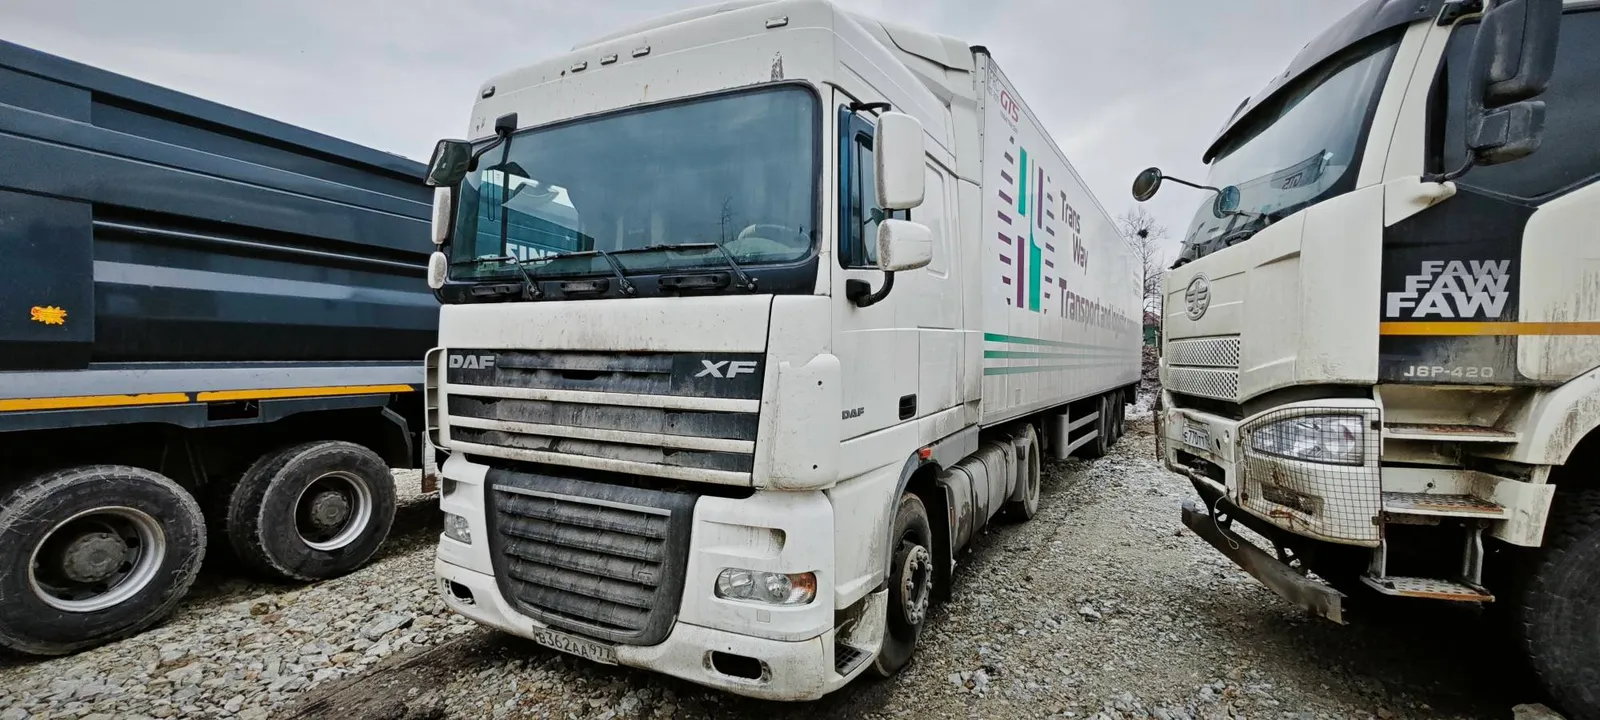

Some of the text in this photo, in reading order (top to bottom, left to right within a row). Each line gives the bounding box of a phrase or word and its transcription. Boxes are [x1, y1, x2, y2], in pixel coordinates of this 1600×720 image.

[1001, 90, 1019, 122] GTS
[1060, 190, 1080, 234] Trans
[1072, 233, 1088, 275] Way
[1421, 260, 1511, 279] FAW
[1405, 275, 1510, 297] FAW
[1059, 277, 1100, 332] Transport
[1386, 291, 1509, 317] FAW
[449, 354, 495, 369] DAF
[694, 359, 758, 378] XF
[1403, 365, 1494, 378] J6P-420
[842, 406, 864, 420] DAF
